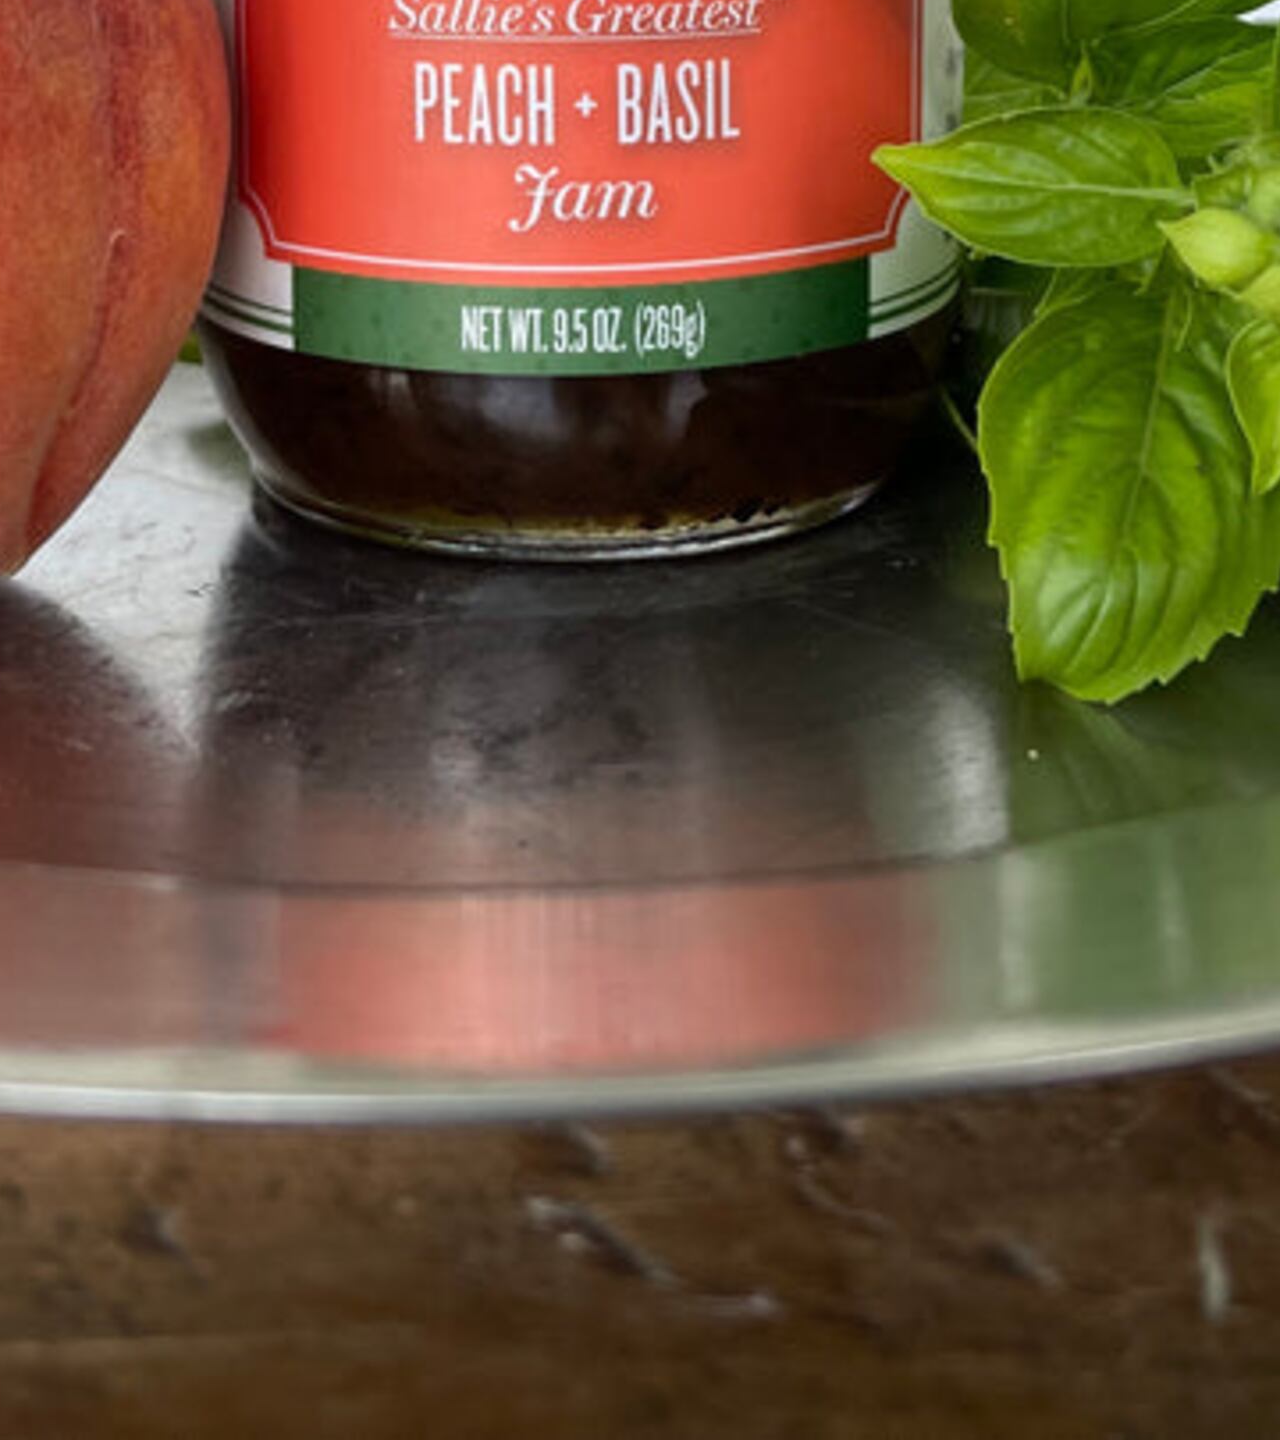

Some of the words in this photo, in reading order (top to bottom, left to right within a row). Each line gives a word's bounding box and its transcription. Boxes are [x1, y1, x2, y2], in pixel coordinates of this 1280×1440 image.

[414, 61, 556, 147] PEACH
[616, 57, 741, 145] BASIL
[507, 162, 659, 233] Jam
[460, 305, 503, 353] NET
[507, 305, 550, 354] WT.
[552, 307, 588, 354] 9.5
[591, 306, 628, 354] OZ.
[633, 299, 707, 360] (269g)
